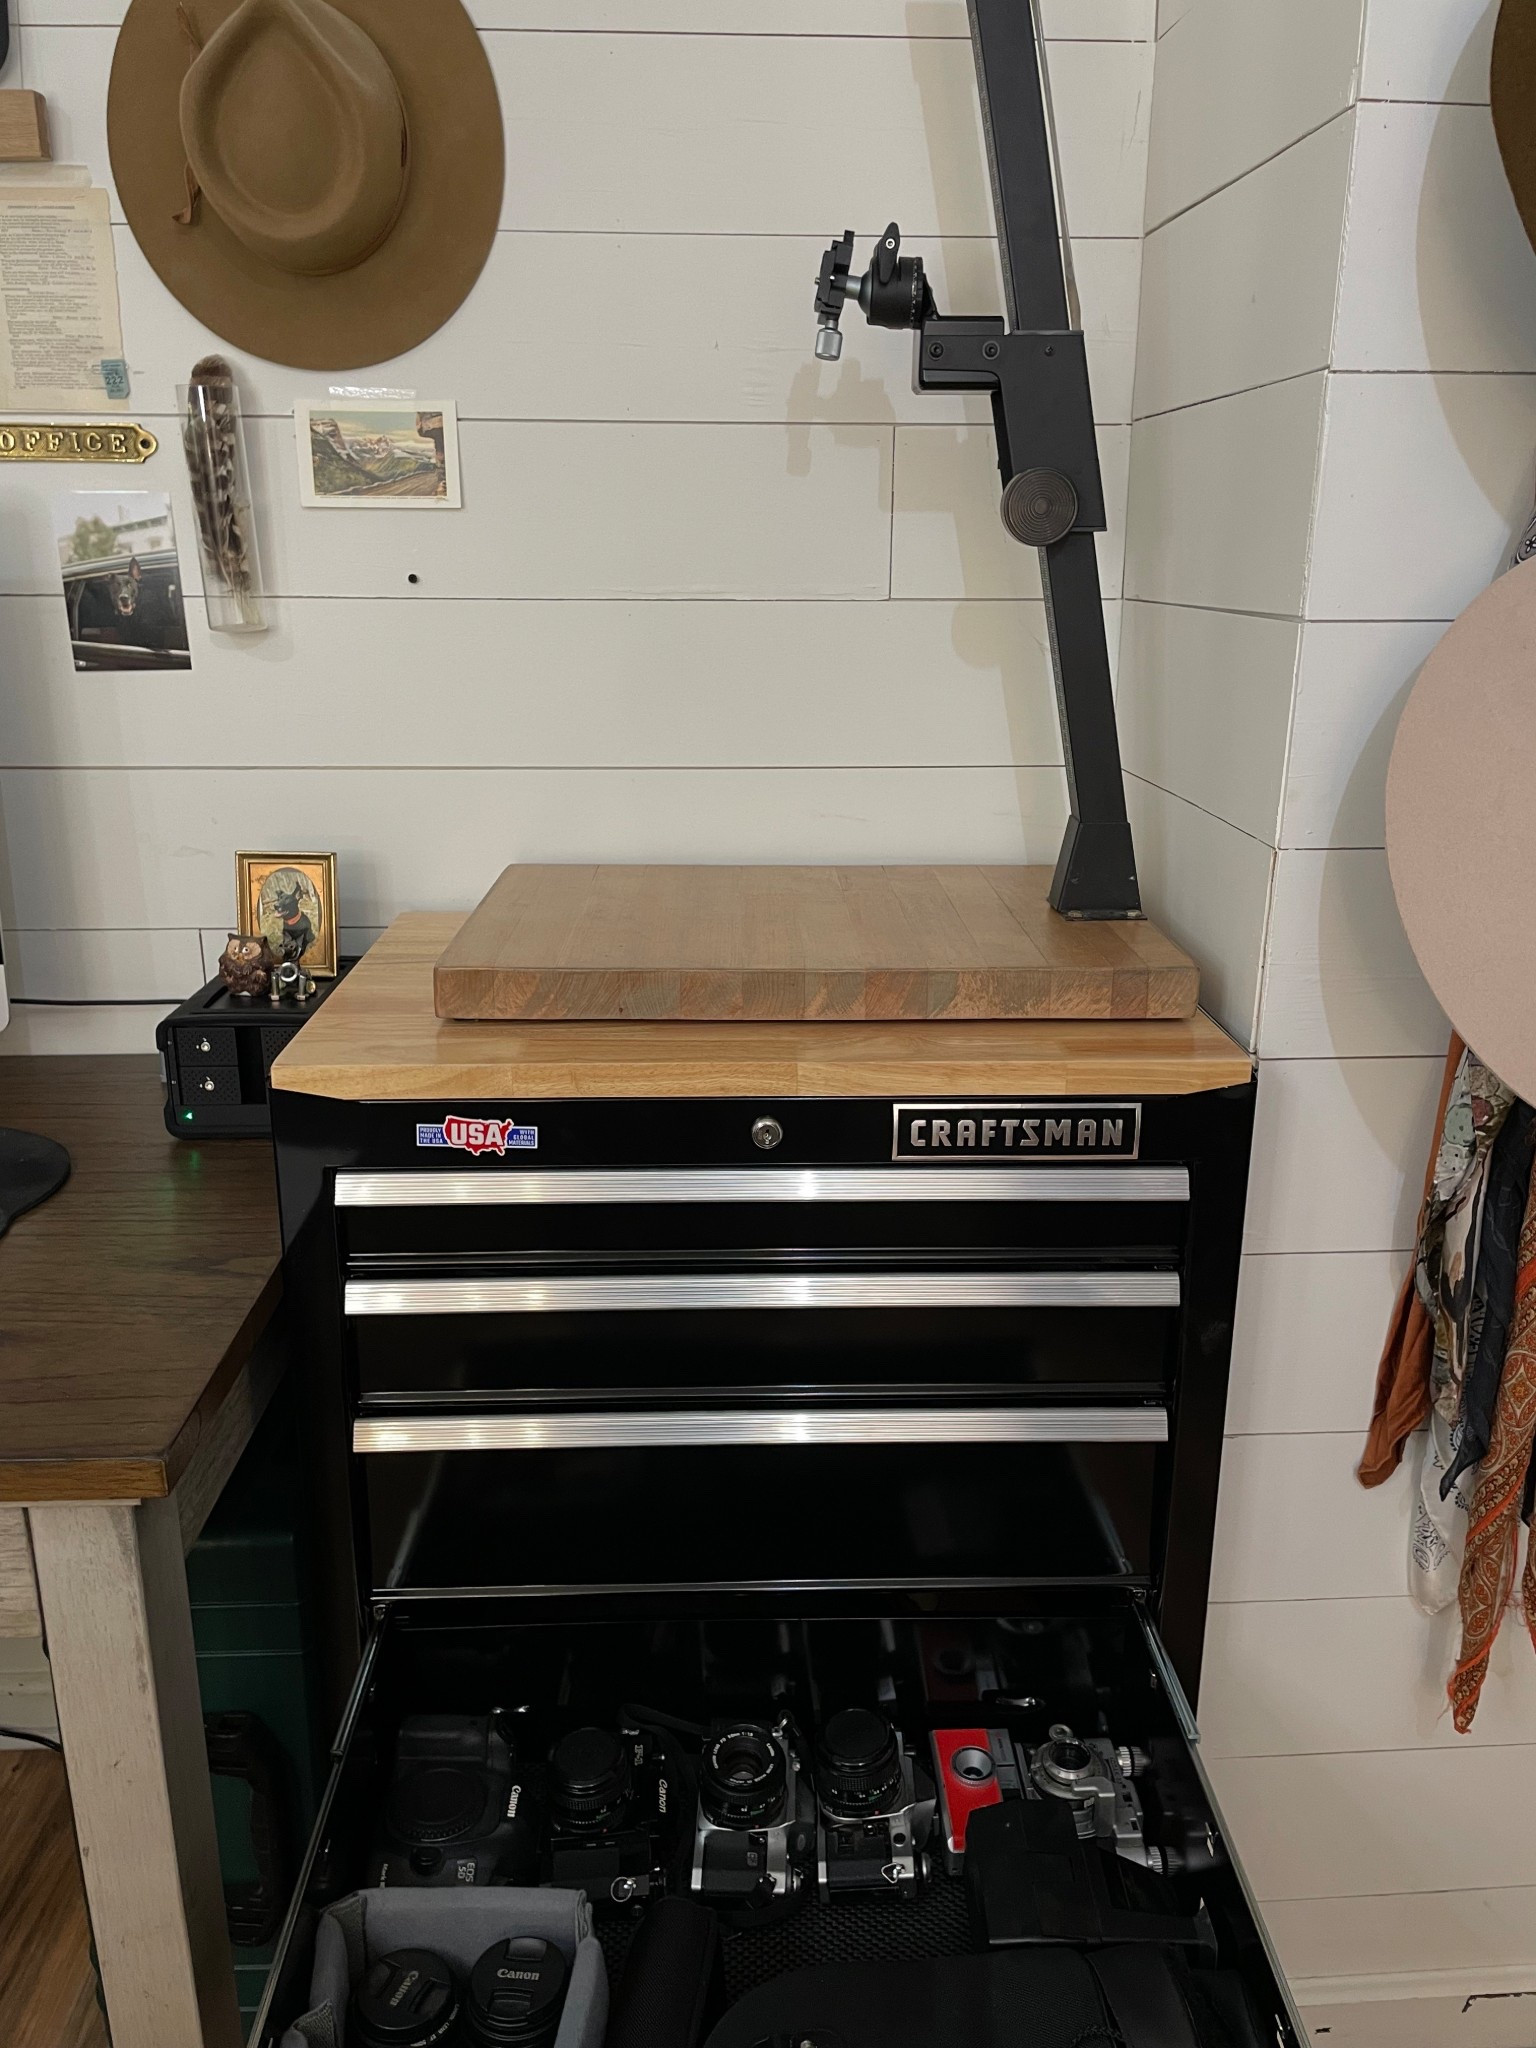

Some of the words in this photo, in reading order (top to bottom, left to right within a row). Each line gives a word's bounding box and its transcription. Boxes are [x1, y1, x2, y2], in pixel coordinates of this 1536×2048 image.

[105, 375, 124, 385] 222
[0, 430, 126, 453] OFFICE
[450, 1122, 504, 1146] USA
[910, 1119, 1124, 1147] CRAFTSMAN
[507, 1785, 521, 1818] Canon
[658, 1779, 668, 1814] Canon
[457, 1865, 466, 1879] 5D
[465, 1862, 475, 1882] EOS
[497, 1968, 540, 1981] Canon
[390, 1970, 419, 2007] Canon
